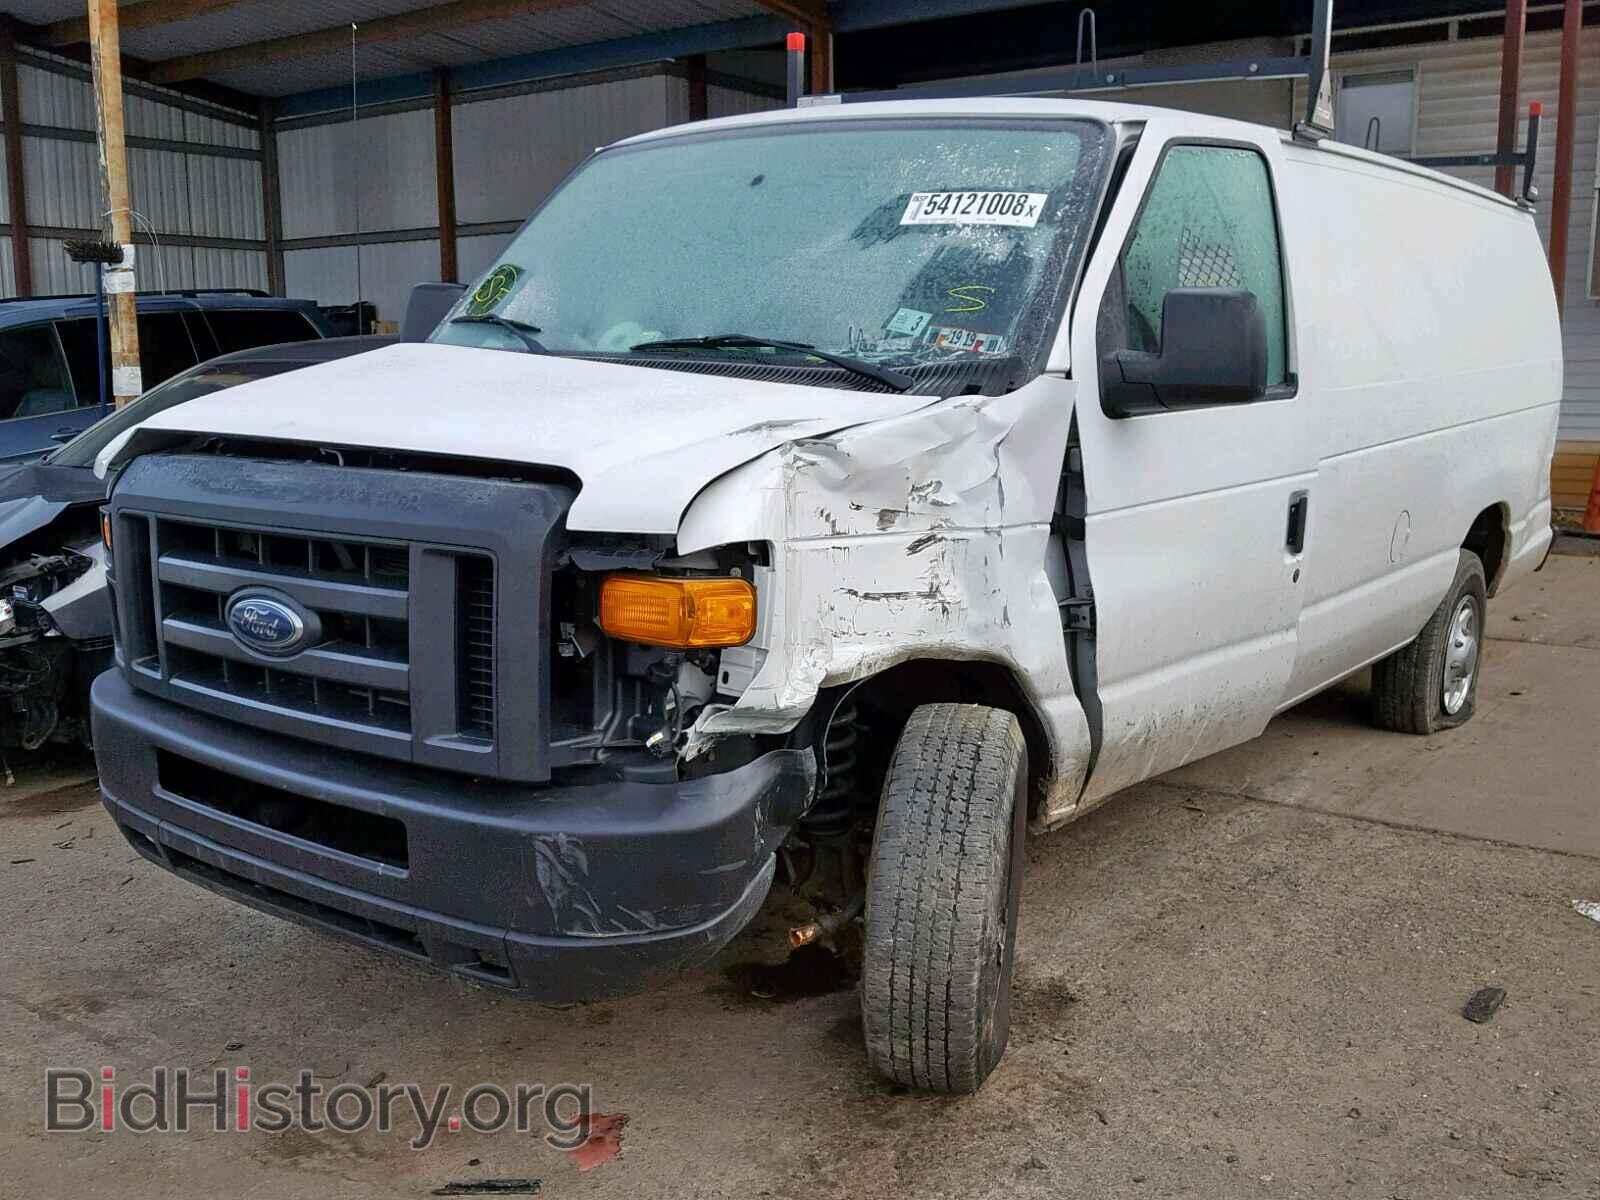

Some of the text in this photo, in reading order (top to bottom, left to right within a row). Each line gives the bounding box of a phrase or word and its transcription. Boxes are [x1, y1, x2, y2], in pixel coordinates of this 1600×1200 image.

[924, 193, 1029, 216] 54121008
[911, 315, 924, 331] 3
[240, 606, 280, 640] Ford
